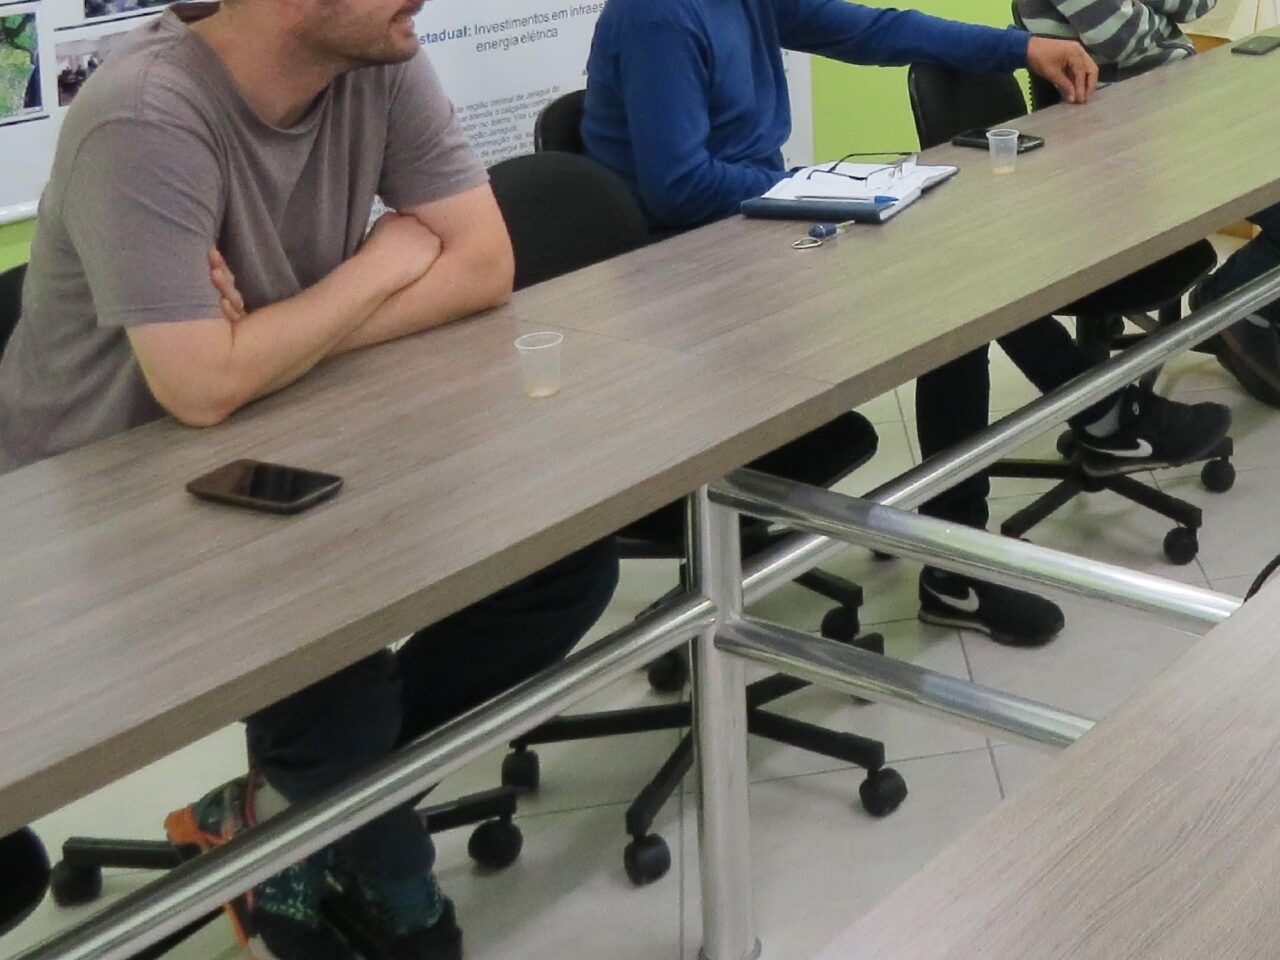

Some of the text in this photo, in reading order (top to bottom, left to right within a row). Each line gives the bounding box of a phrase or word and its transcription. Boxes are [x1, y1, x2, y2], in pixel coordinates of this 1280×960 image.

[417, 25, 472, 46] stadual:
[474, 10, 550, 35] Investimentos
[552, 8, 568, 21] em
[476, 26, 559, 54] energia elétrica
